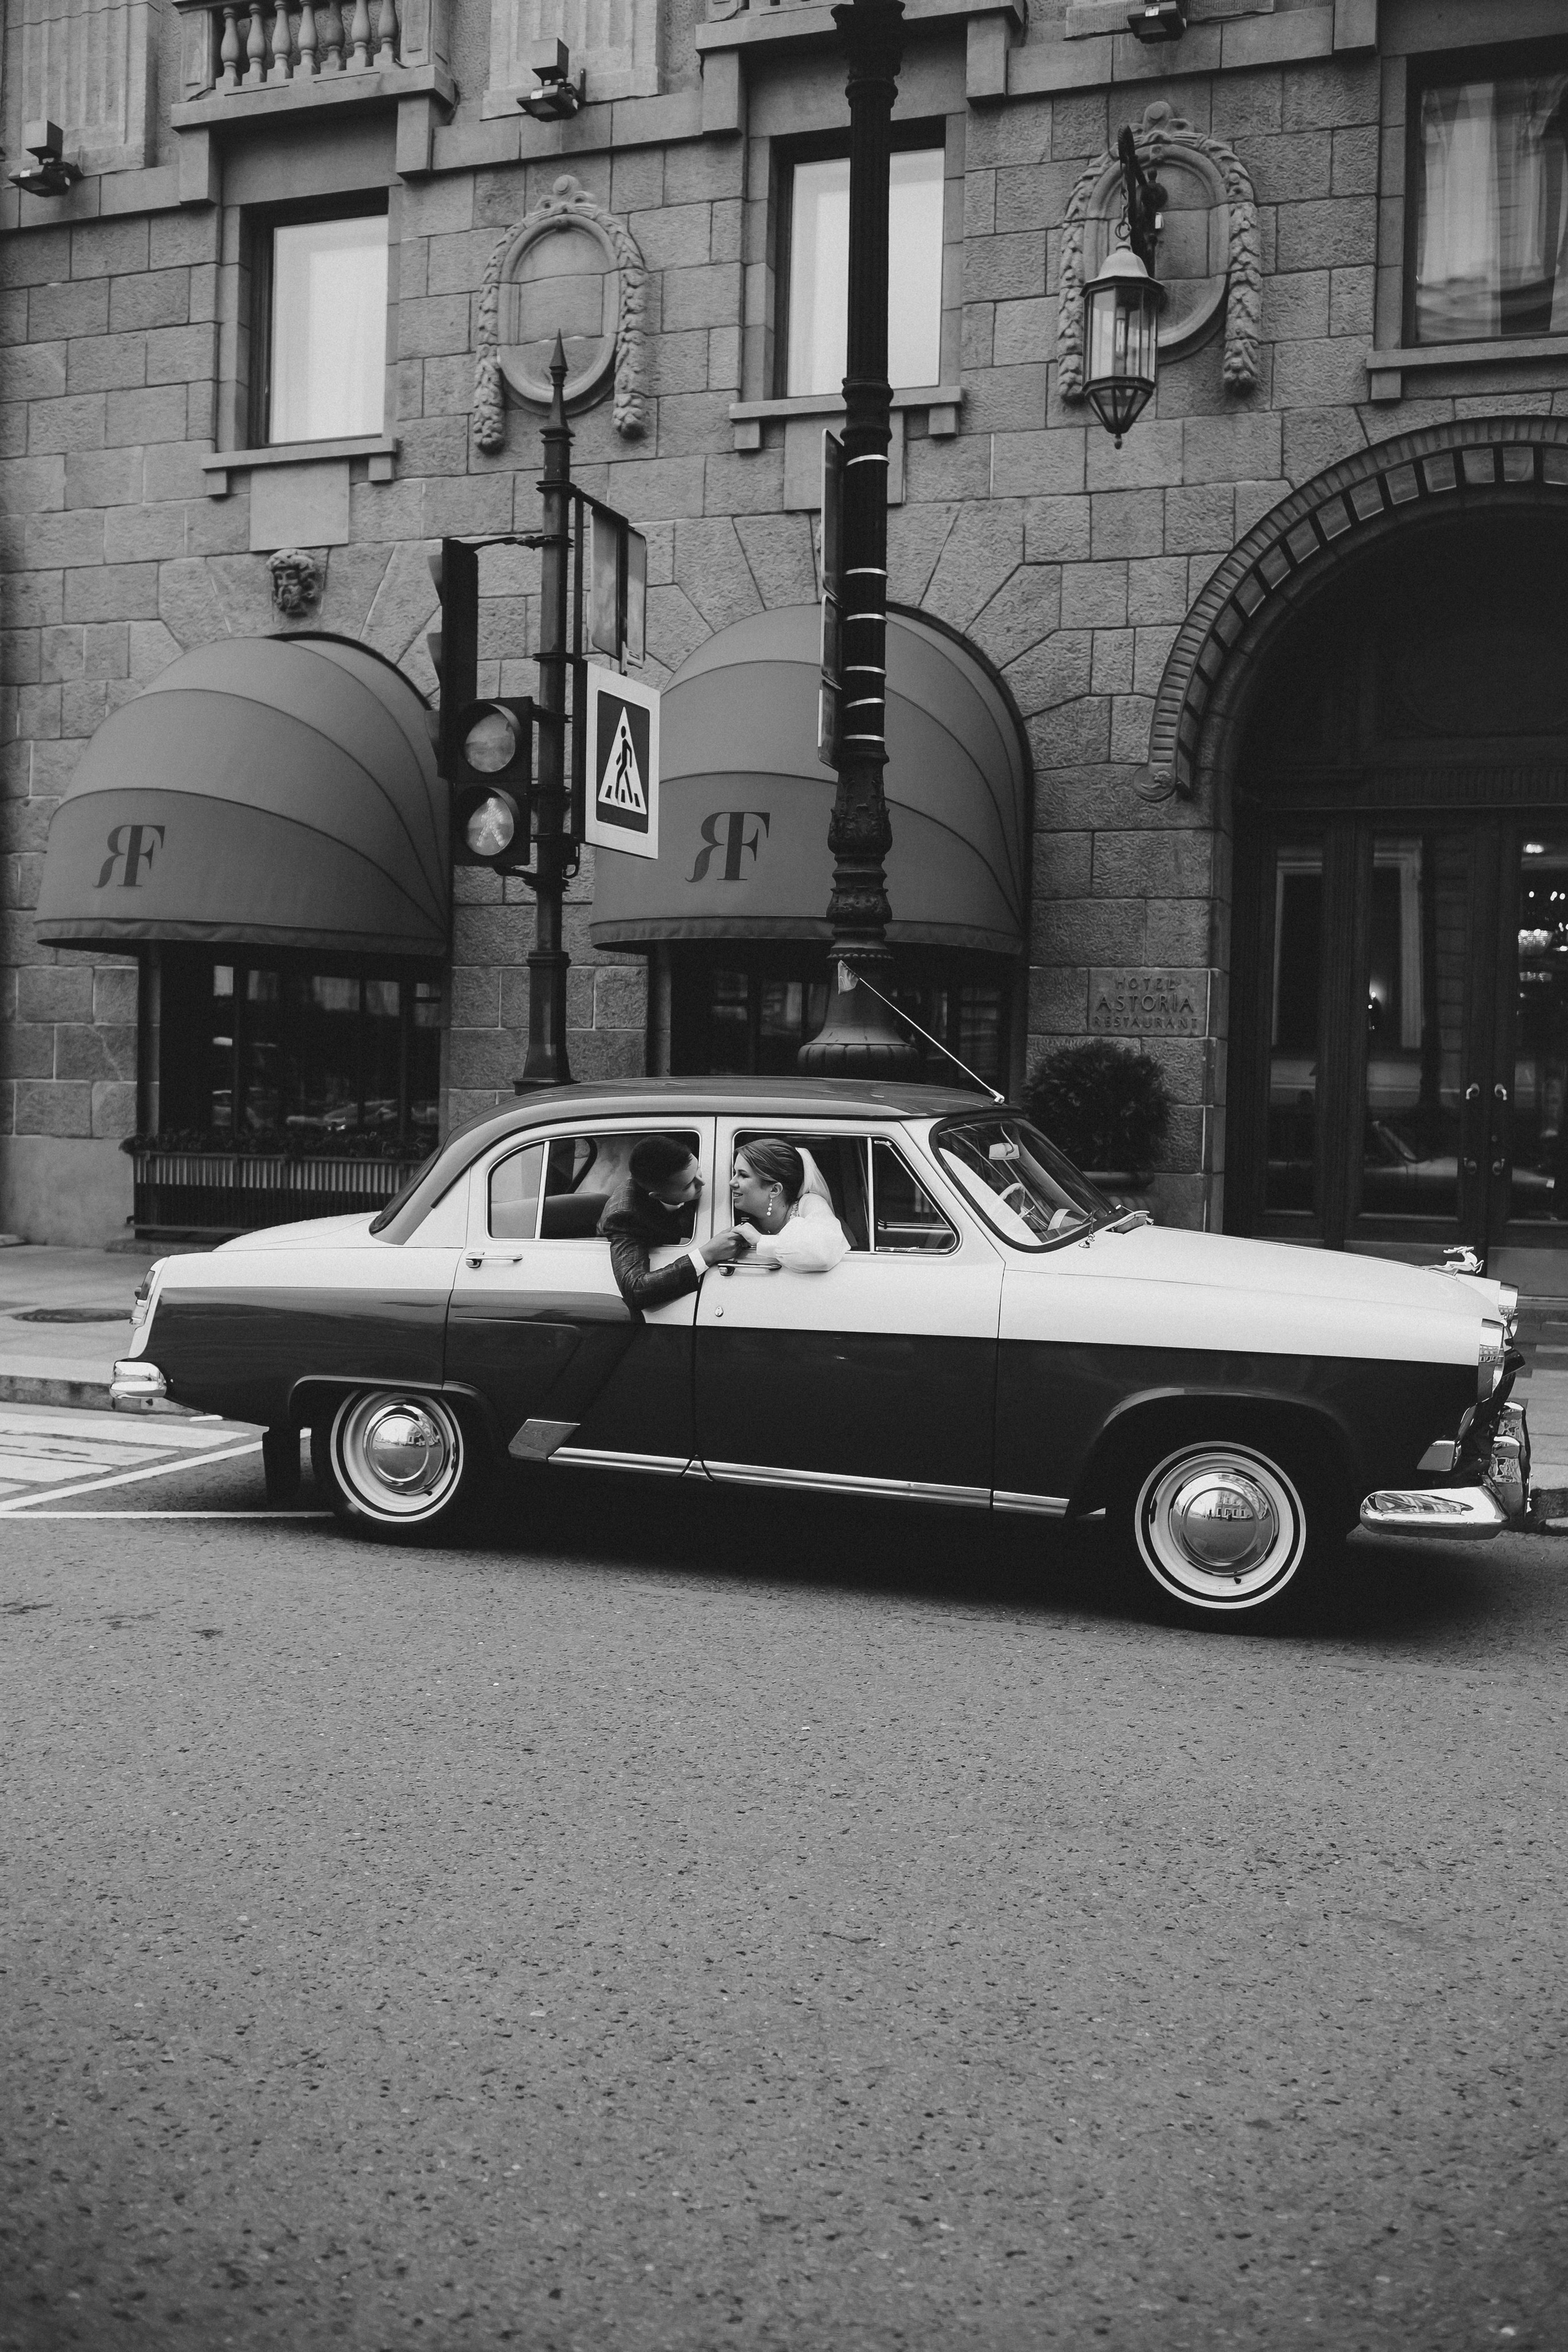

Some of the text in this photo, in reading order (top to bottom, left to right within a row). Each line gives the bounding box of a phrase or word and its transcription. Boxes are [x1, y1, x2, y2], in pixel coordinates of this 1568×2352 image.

[1115, 978, 1177, 990] HOTEL
[1096, 994, 1194, 1012] ASTORIA
[1093, 1016, 1198, 1029] RESTAURANT
